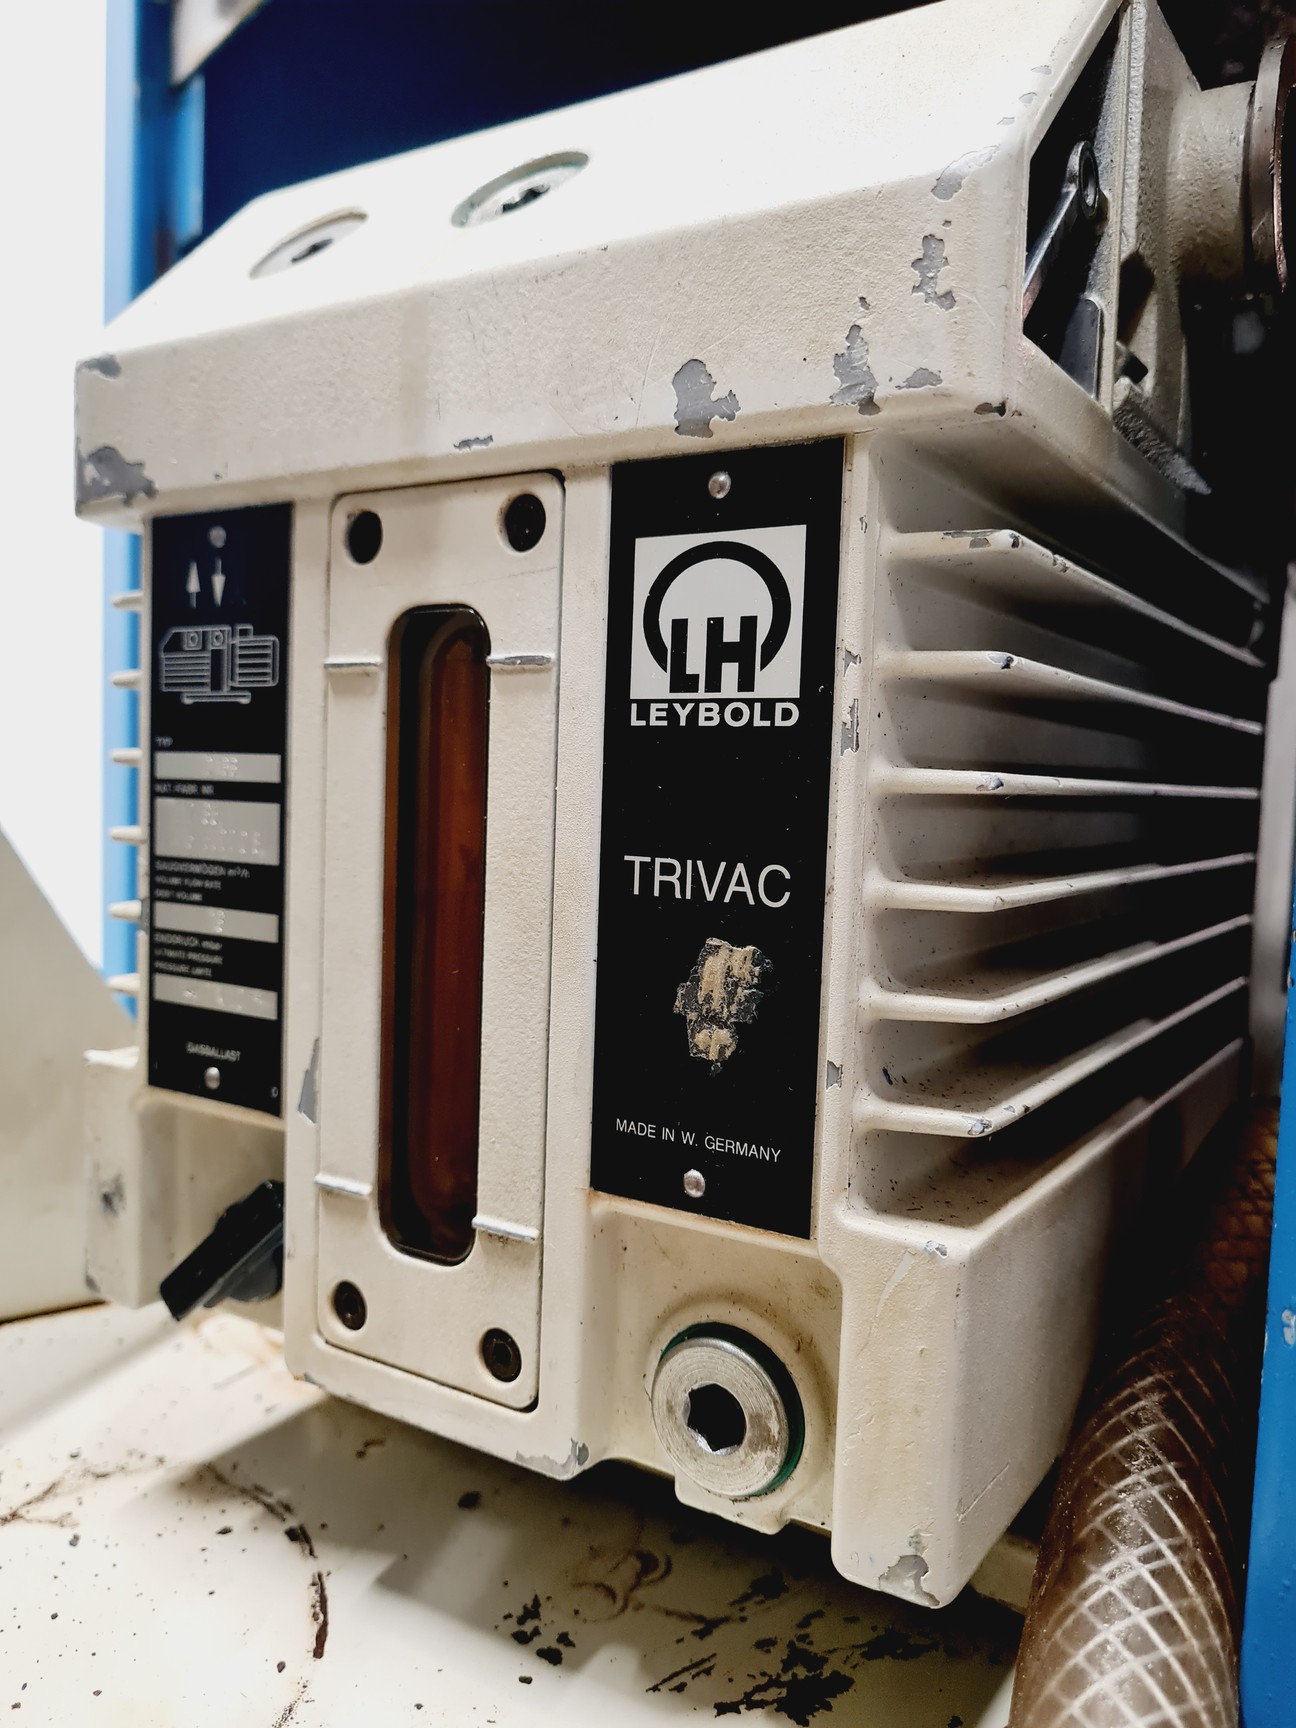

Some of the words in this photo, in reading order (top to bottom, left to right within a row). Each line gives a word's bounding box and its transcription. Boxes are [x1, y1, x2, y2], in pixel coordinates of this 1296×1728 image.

[630, 702, 800, 727] LEYBOLD
[623, 855, 792, 909] TRIVAC
[186, 1041, 241, 1062] GASBALLAST
[615, 1117, 657, 1140] MADE
[661, 1126, 675, 1143] IN
[681, 1130, 698, 1147] W.
[704, 1135, 782, 1163] GERMANY
